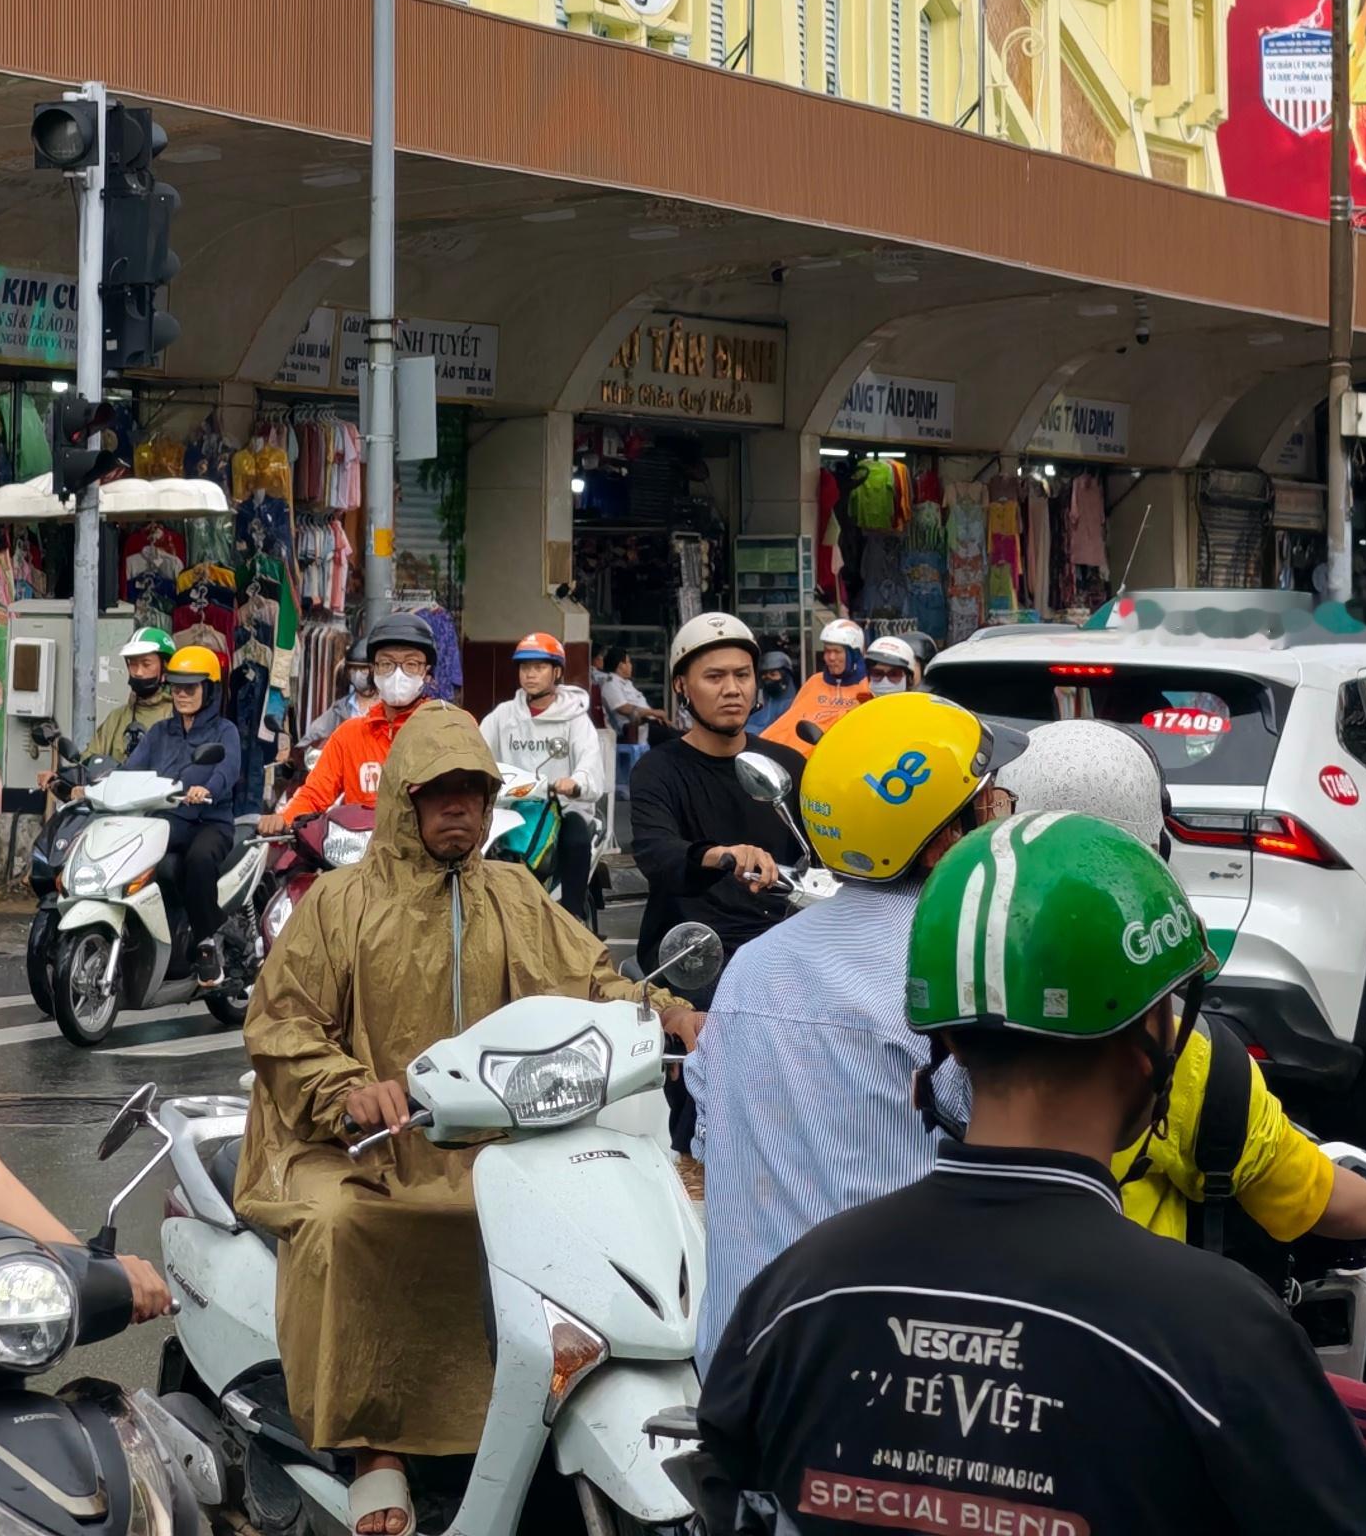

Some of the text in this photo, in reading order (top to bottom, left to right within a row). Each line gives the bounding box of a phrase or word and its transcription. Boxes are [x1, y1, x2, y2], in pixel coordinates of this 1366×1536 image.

[1, 277, 48, 308] KIM
[428, 325, 482, 359] TUYẾT
[1152, 712, 1223, 732] 17409
[508, 733, 552, 752] levent
[863, 751, 932, 805] be
[1122, 896, 1192, 965] Grab
[809, 1479, 949, 1525] SPECIAL
